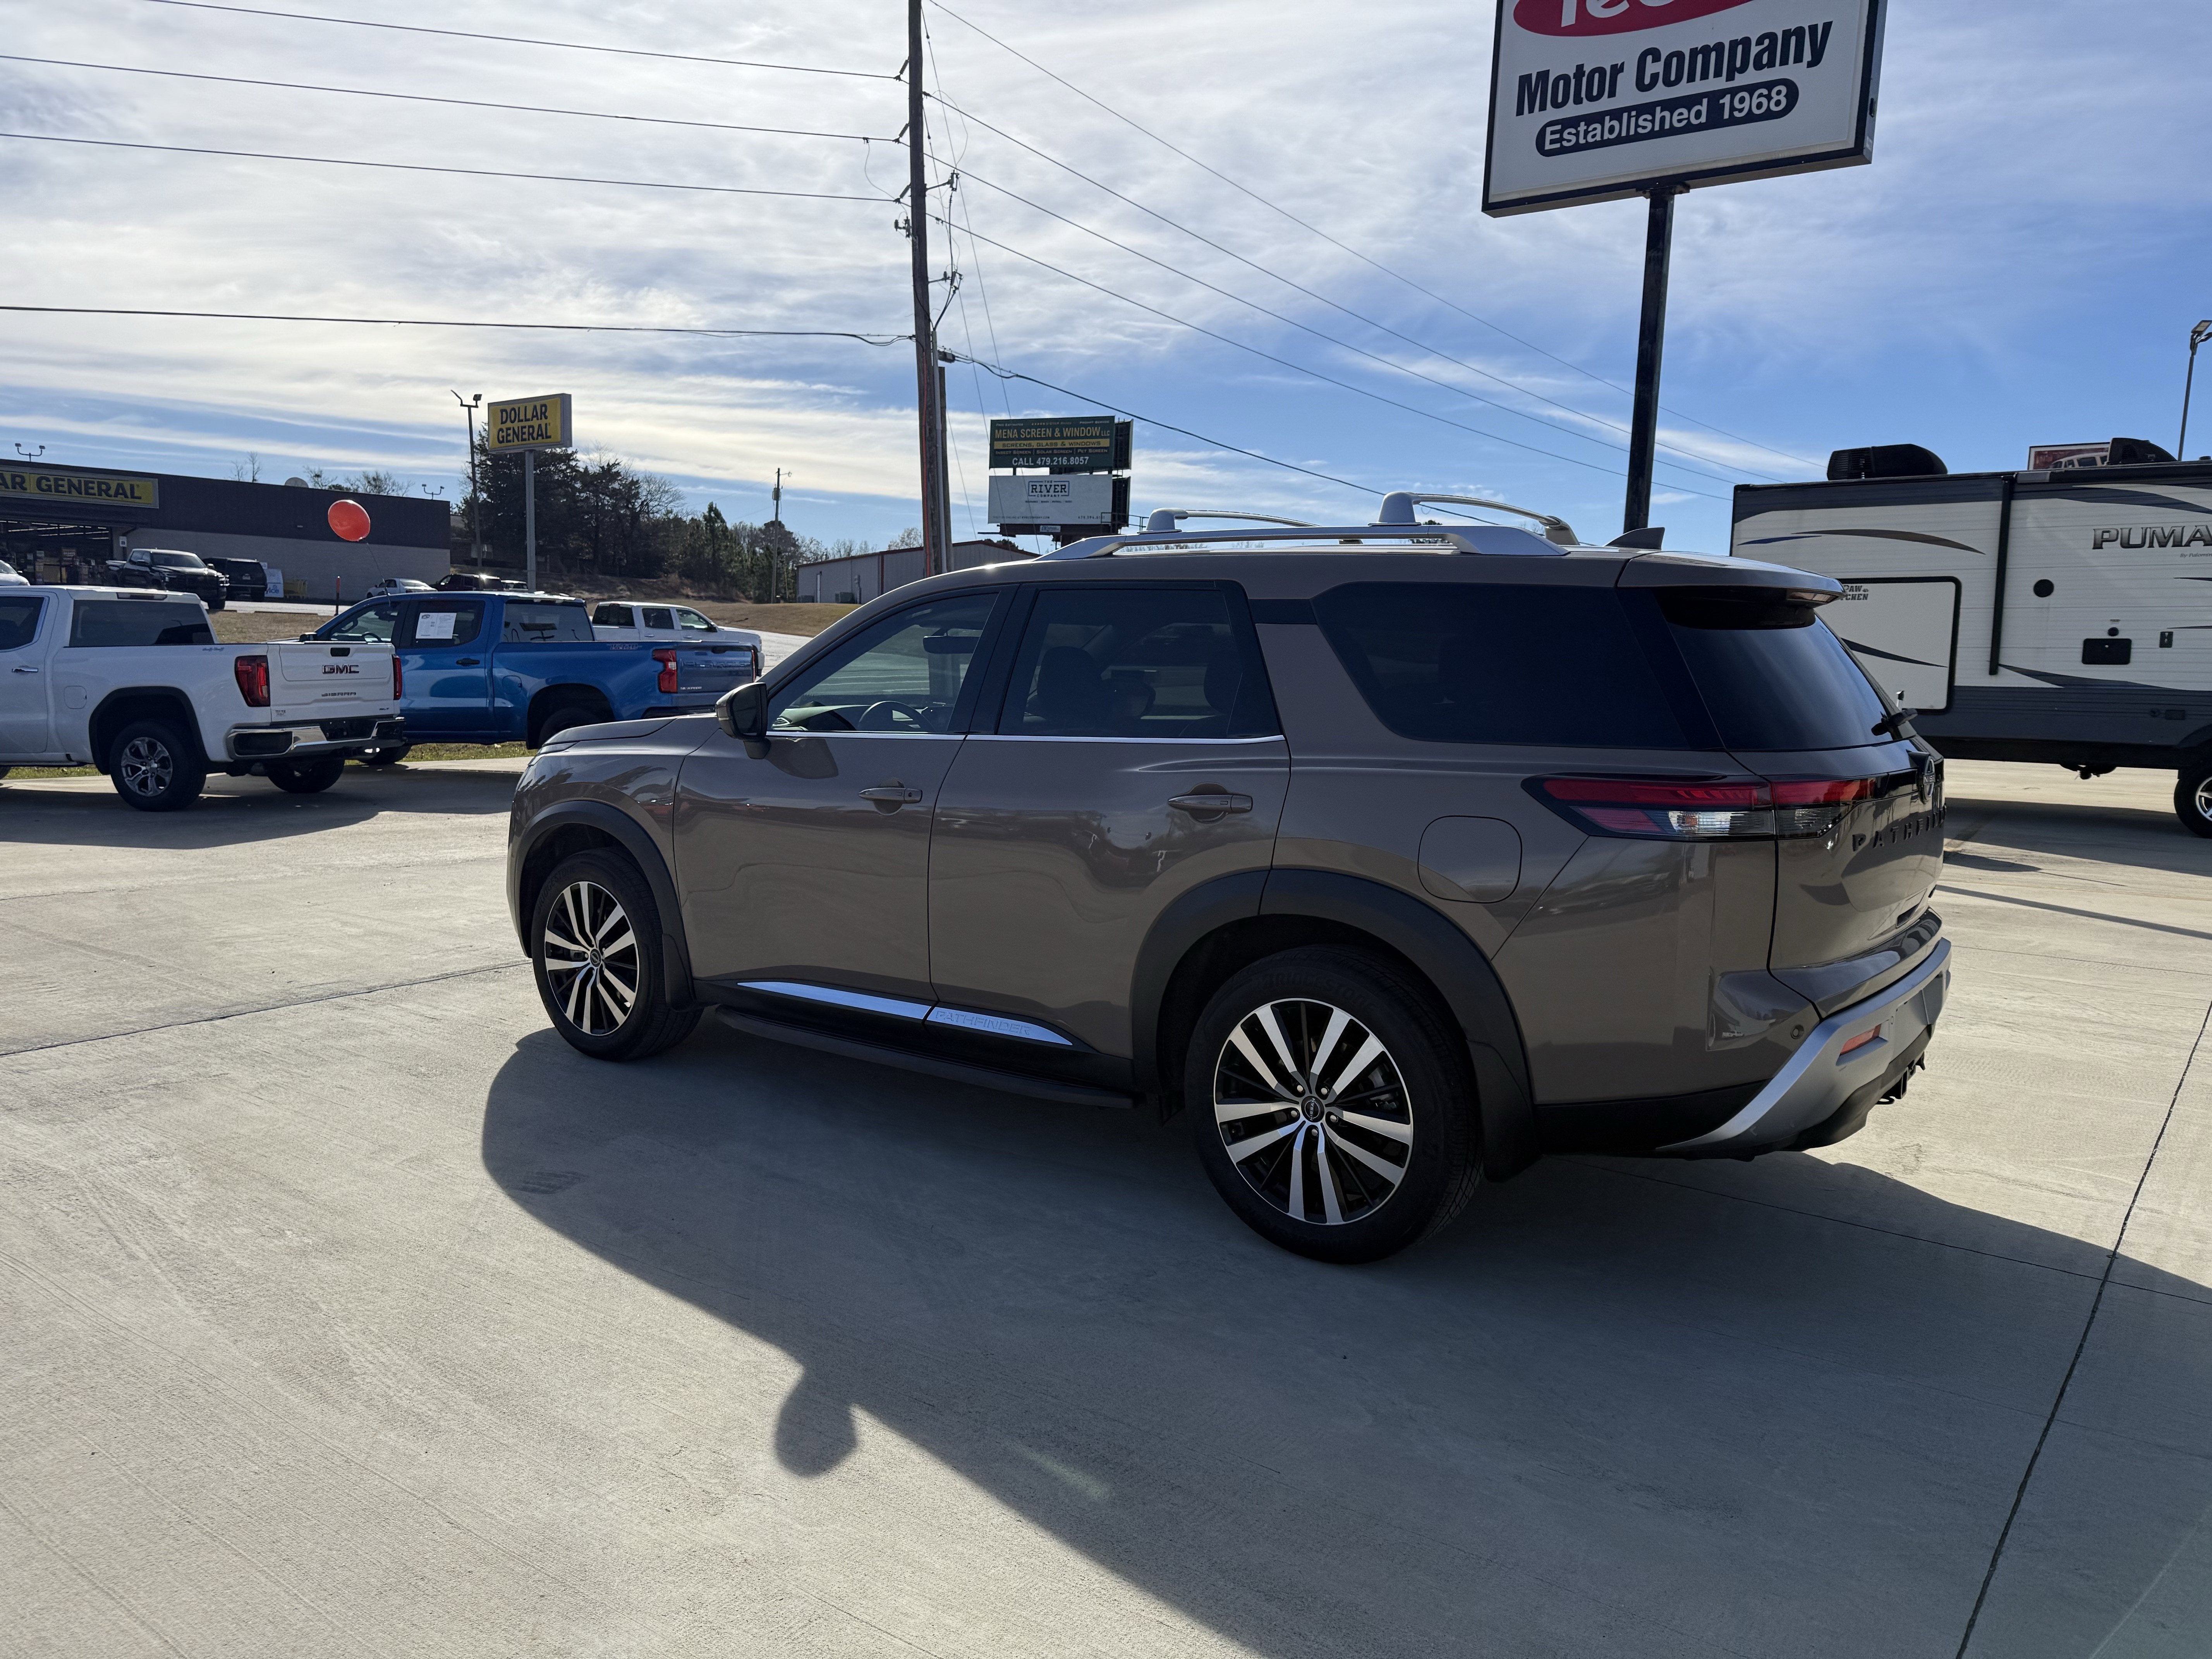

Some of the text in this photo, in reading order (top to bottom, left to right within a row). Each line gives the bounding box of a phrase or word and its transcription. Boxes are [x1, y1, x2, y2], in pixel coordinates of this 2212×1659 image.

[1516, 21, 1833, 117] Motor Company
[1544, 85, 1787, 150] Established 1968
[500, 404, 548, 424] DOLLAR
[497, 422, 552, 444] GENERAL
[995, 429, 1018, 438] MENA
[1020, 428, 1052, 438] SCREEN
[1054, 428, 1060, 437] &
[1063, 427, 1100, 437] WINDOW
[1012, 457, 1089, 465] CALL 479.216.8057
[36, 476, 142, 500] GENERAL
[1031, 484, 1067, 493] RIVER
[2092, 525, 2212, 550] PUMA
[322, 664, 359, 674] GMC
[936, 1010, 1032, 1035] PATHFINDER
